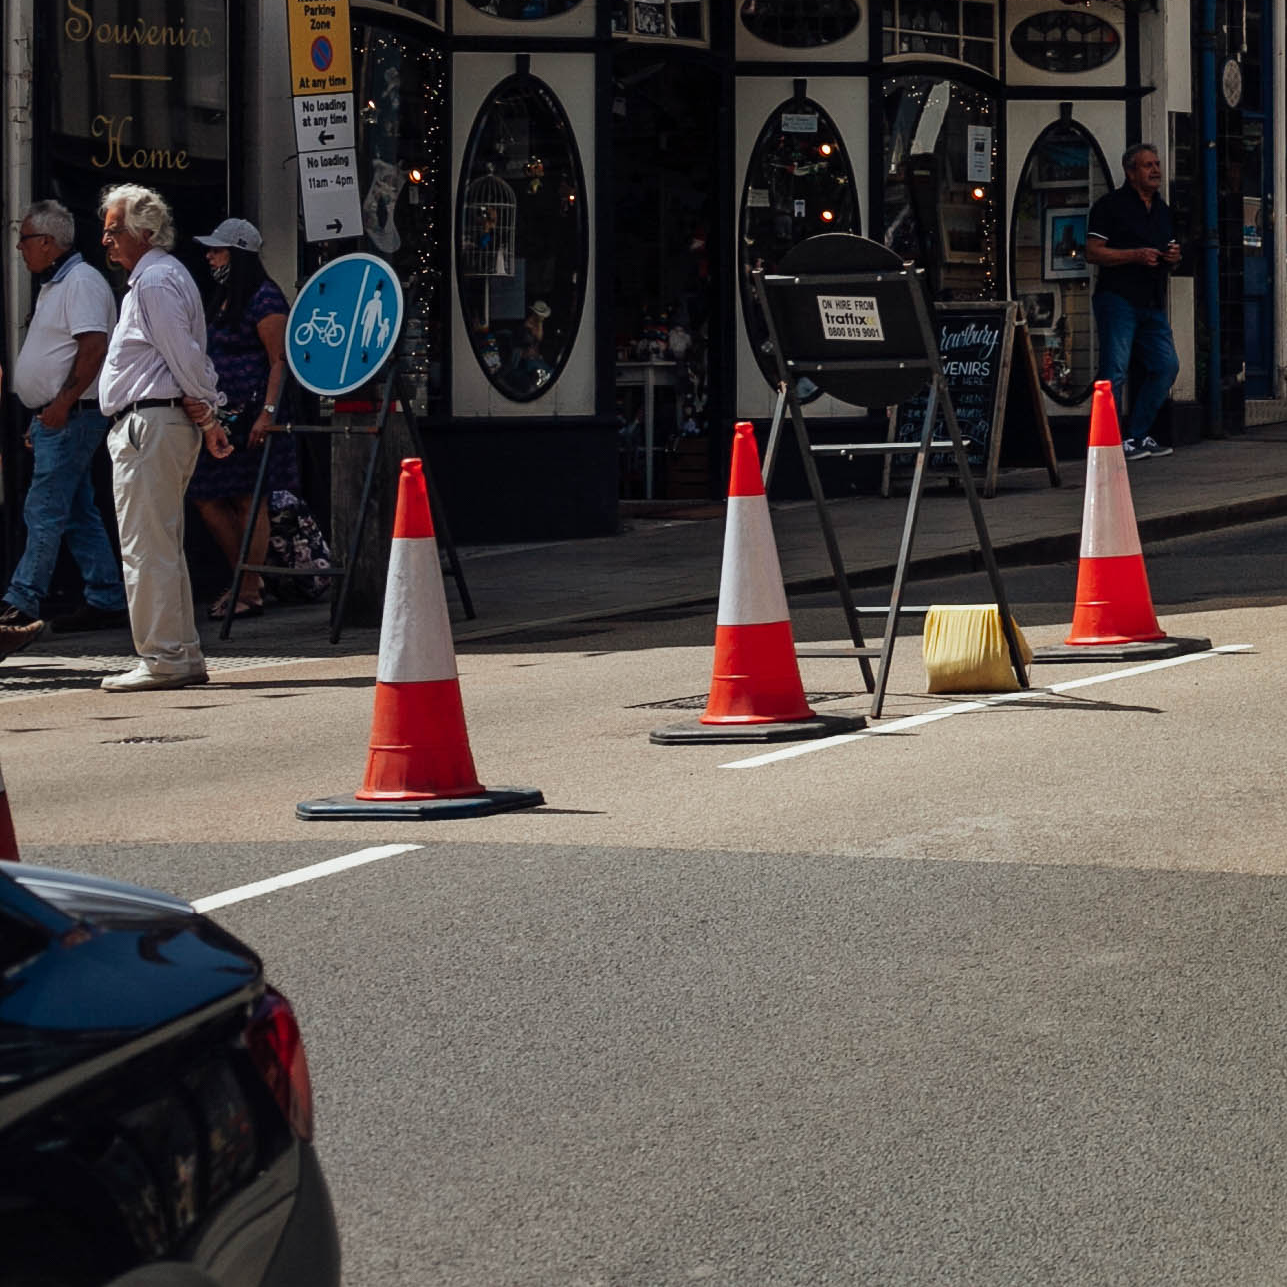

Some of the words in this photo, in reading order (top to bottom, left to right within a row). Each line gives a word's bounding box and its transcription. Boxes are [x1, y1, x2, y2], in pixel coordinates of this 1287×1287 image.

[304, 4, 336, 17] Parking
[310, 19, 331, 30] Zone
[300, 77, 310, 89] At
[312, 78, 326, 89] any
[328, 75, 347, 87] time
[302, 101, 315, 113] No
[317, 99, 347, 112] loading
[302, 117, 311, 127] at
[314, 117, 328, 127] any
[330, 114, 348, 124] time
[91, 115, 191, 170] Home
[307, 157, 319, 169] No
[321, 155, 350, 168] loading
[309, 177, 329, 189] 11am
[336, 175, 354, 187] 4pm
[822, 299, 833, 310] ON
[835, 299, 852, 310] HIRE
[855, 300, 875, 311] FROM
[824, 312, 867, 325] traffix
[828, 327, 846, 337] 0800
[862, 327, 880, 338] 9001
[942, 362, 990, 376] VENIRS
